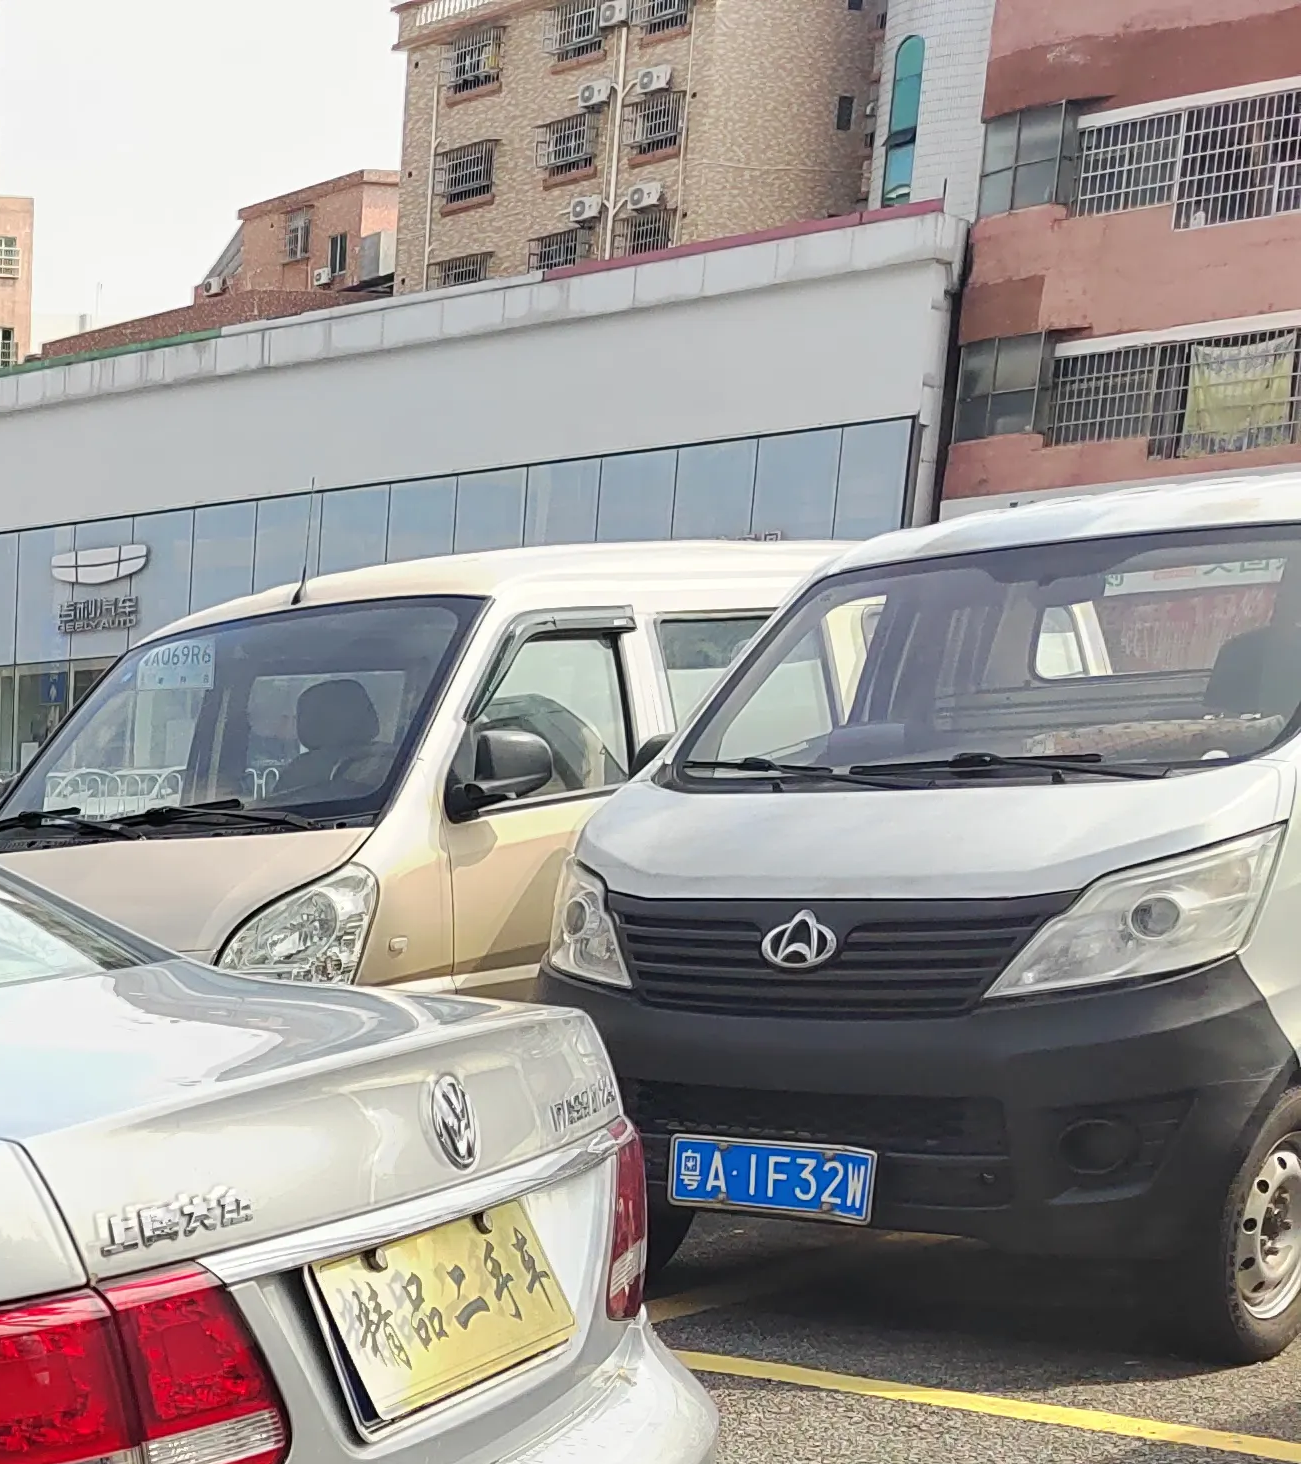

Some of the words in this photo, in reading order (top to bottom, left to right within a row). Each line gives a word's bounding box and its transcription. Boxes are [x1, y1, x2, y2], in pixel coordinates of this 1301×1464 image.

[57, 595, 137, 621] 吉利汽车
[99, 615, 137, 630] AUTO
[350, 1225, 554, 1371] 精品二手车
